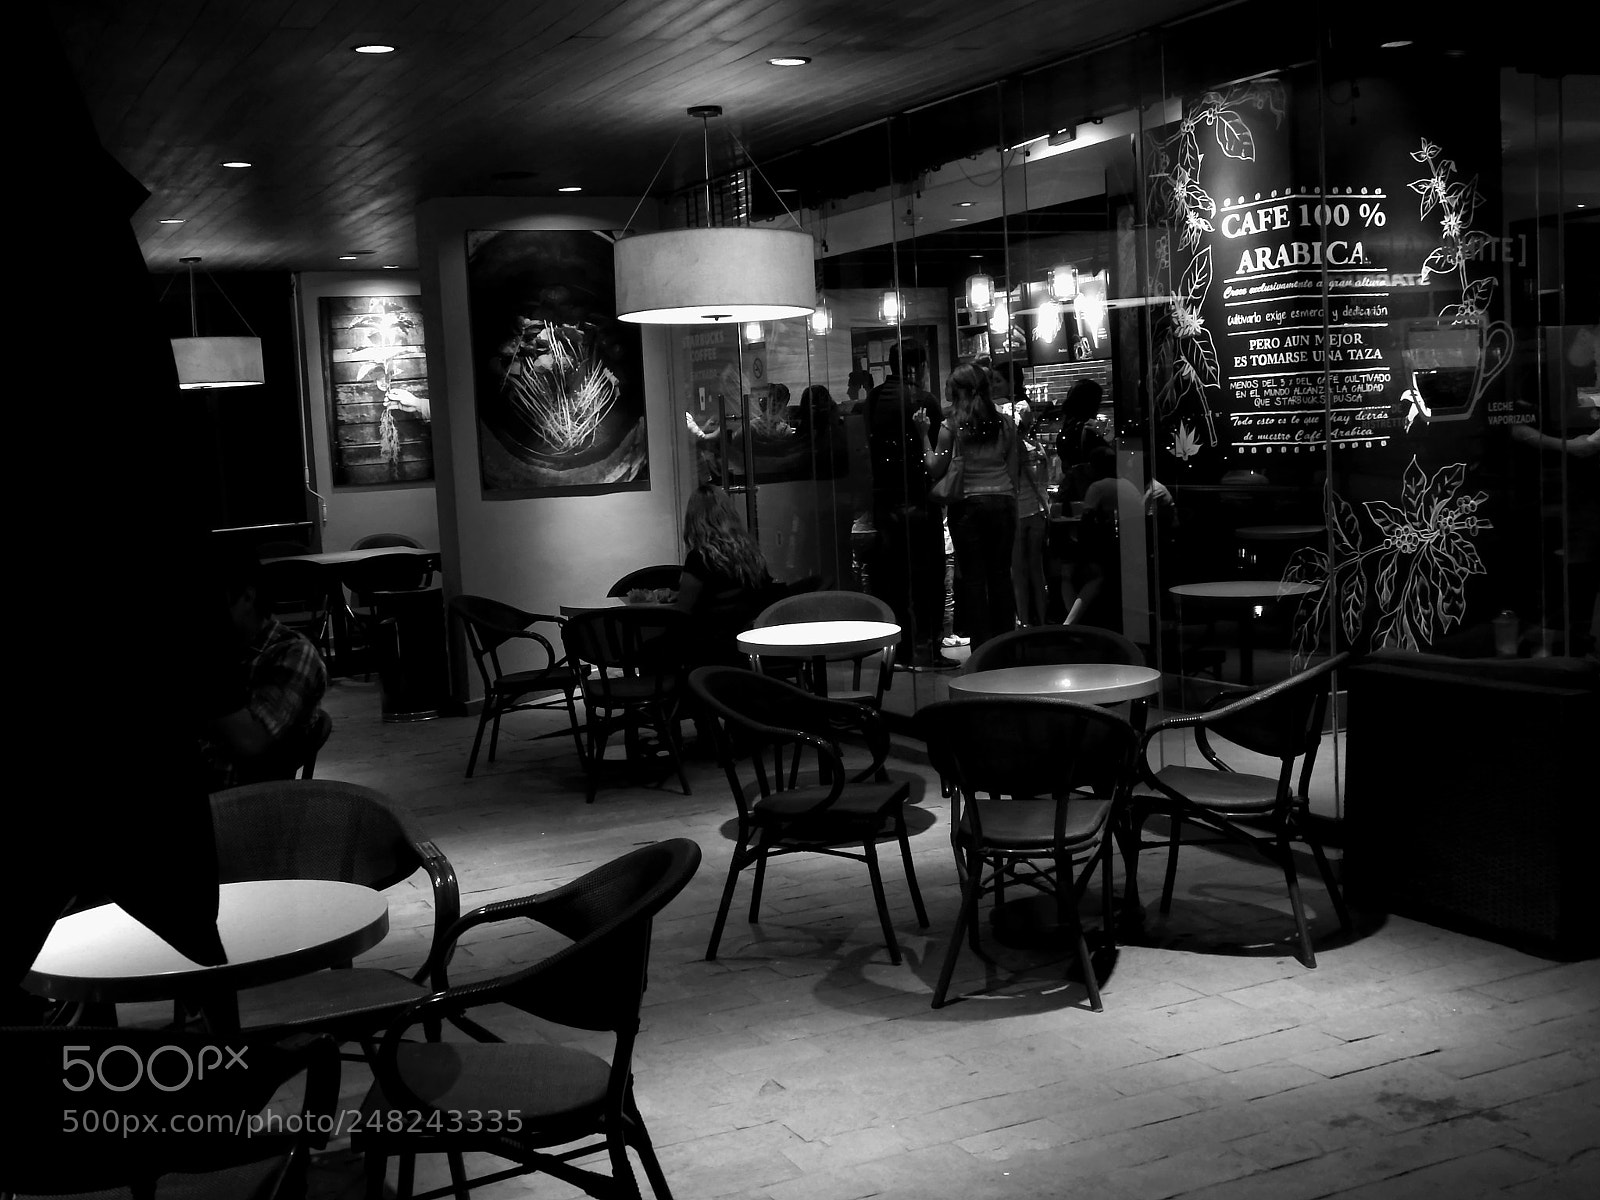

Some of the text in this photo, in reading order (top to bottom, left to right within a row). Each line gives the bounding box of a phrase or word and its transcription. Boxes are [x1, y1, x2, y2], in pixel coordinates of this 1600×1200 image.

[1221, 202, 1387, 238] CAFE 100 %
[1248, 279, 1314, 294] exclusivamente
[1316, 279, 1323, 288] a
[1328, 278, 1353, 291] gran
[1354, 276, 1388, 288] altura
[1265, 309, 1287, 325] exige
[1332, 308, 1339, 321] y
[1342, 304, 1388, 317] dedicación
[1249, 332, 1363, 351] PERO AUN MEJOR
[1234, 348, 1383, 368] ES TOMARSE UNA TAZA
[1229, 379, 1259, 390] MENOS
[1262, 378, 1278, 388] DEL
[1296, 377, 1313, 386] DEL
[1344, 372, 1392, 383] CULTIVADO
[1235, 389, 1247, 399] EN
[1249, 388, 1260, 398] EL
[1263, 387, 1290, 397] MUNDO
[1336, 385, 1347, 393] LA
[1351, 383, 1384, 393] CALIDAD
[1254, 393, 1363, 409] QUE STARBUCKS BUSCA
[1487, 401, 1514, 412] LECHE
[1230, 410, 1389, 427] Todo esto es lo que hay detrás
[1487, 413, 1536, 425] VAPORIZADA
[1243, 427, 1374, 443] de nuestro Café Arabica
